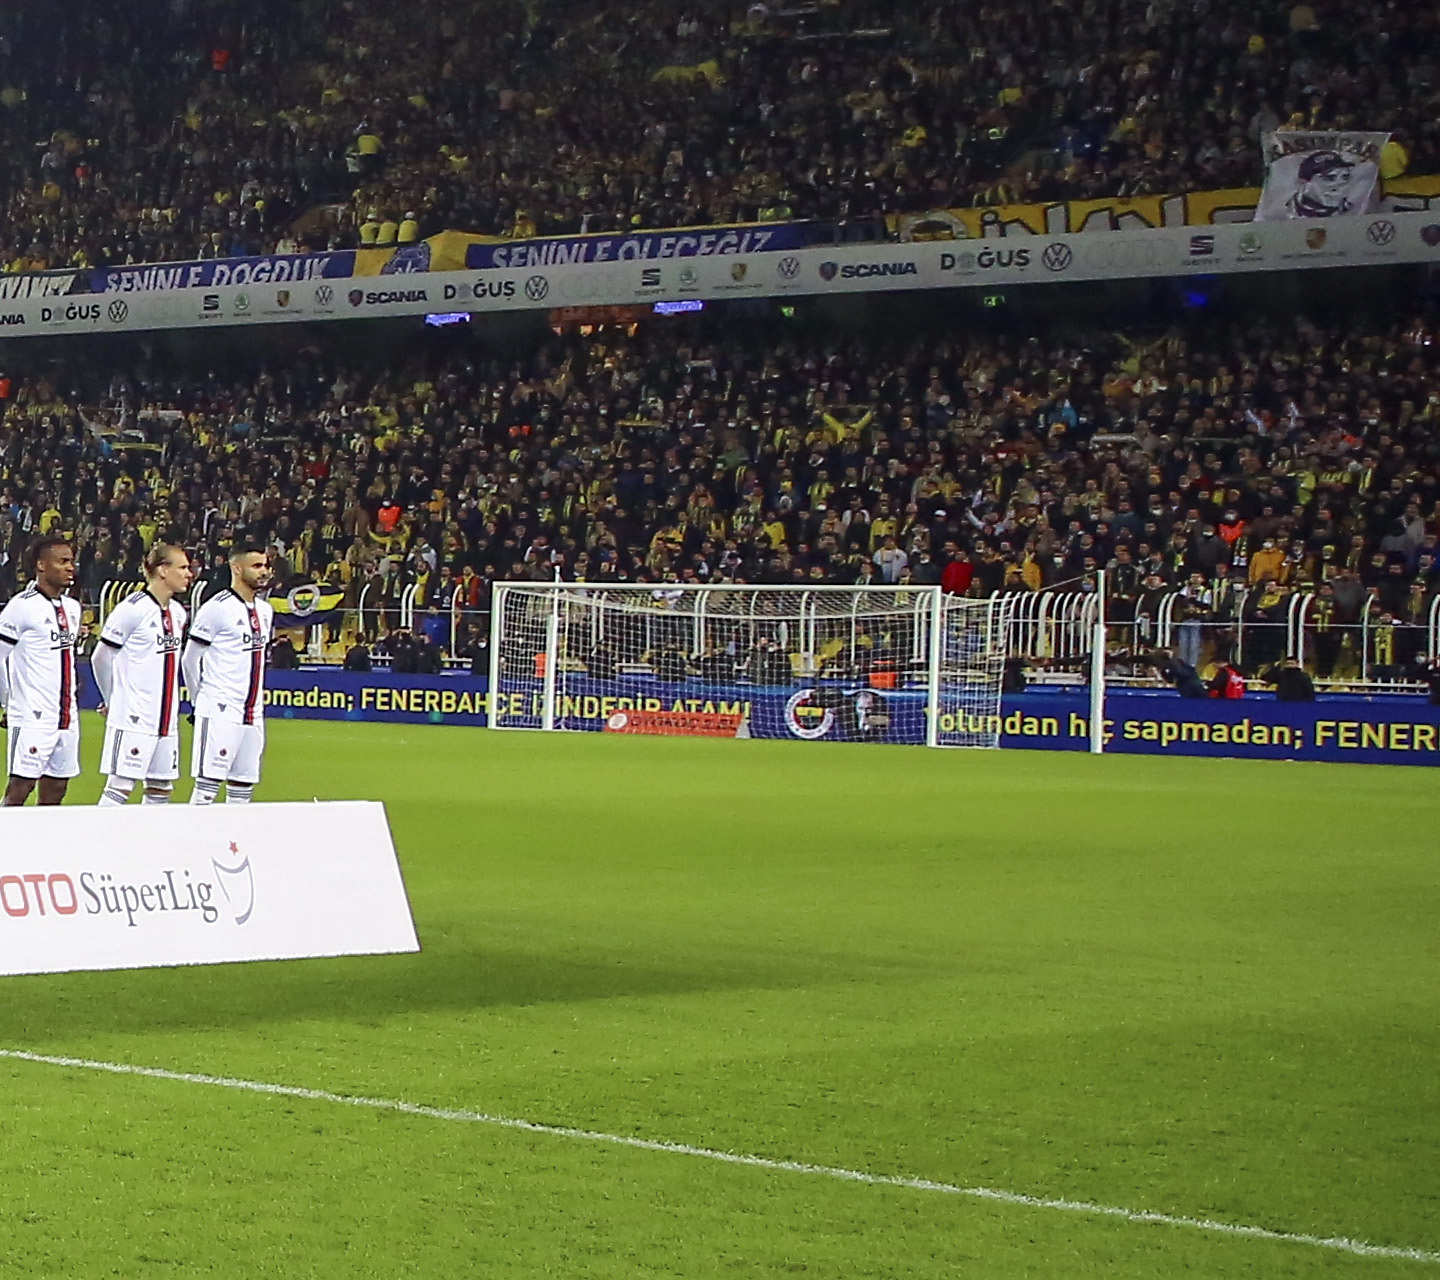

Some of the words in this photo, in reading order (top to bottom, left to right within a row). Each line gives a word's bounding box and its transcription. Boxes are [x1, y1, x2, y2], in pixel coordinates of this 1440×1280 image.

[365, 288, 428, 305] SCANIA
[840, 261, 918, 279] SCANIA
[924, 708, 1059, 738] olundan
[1069, 712, 1114, 745] hç
[1124, 718, 1304, 751] sapmadan;
[1315, 720, 1440, 753] FENER
[81, 869, 220, 927] SüperLig
